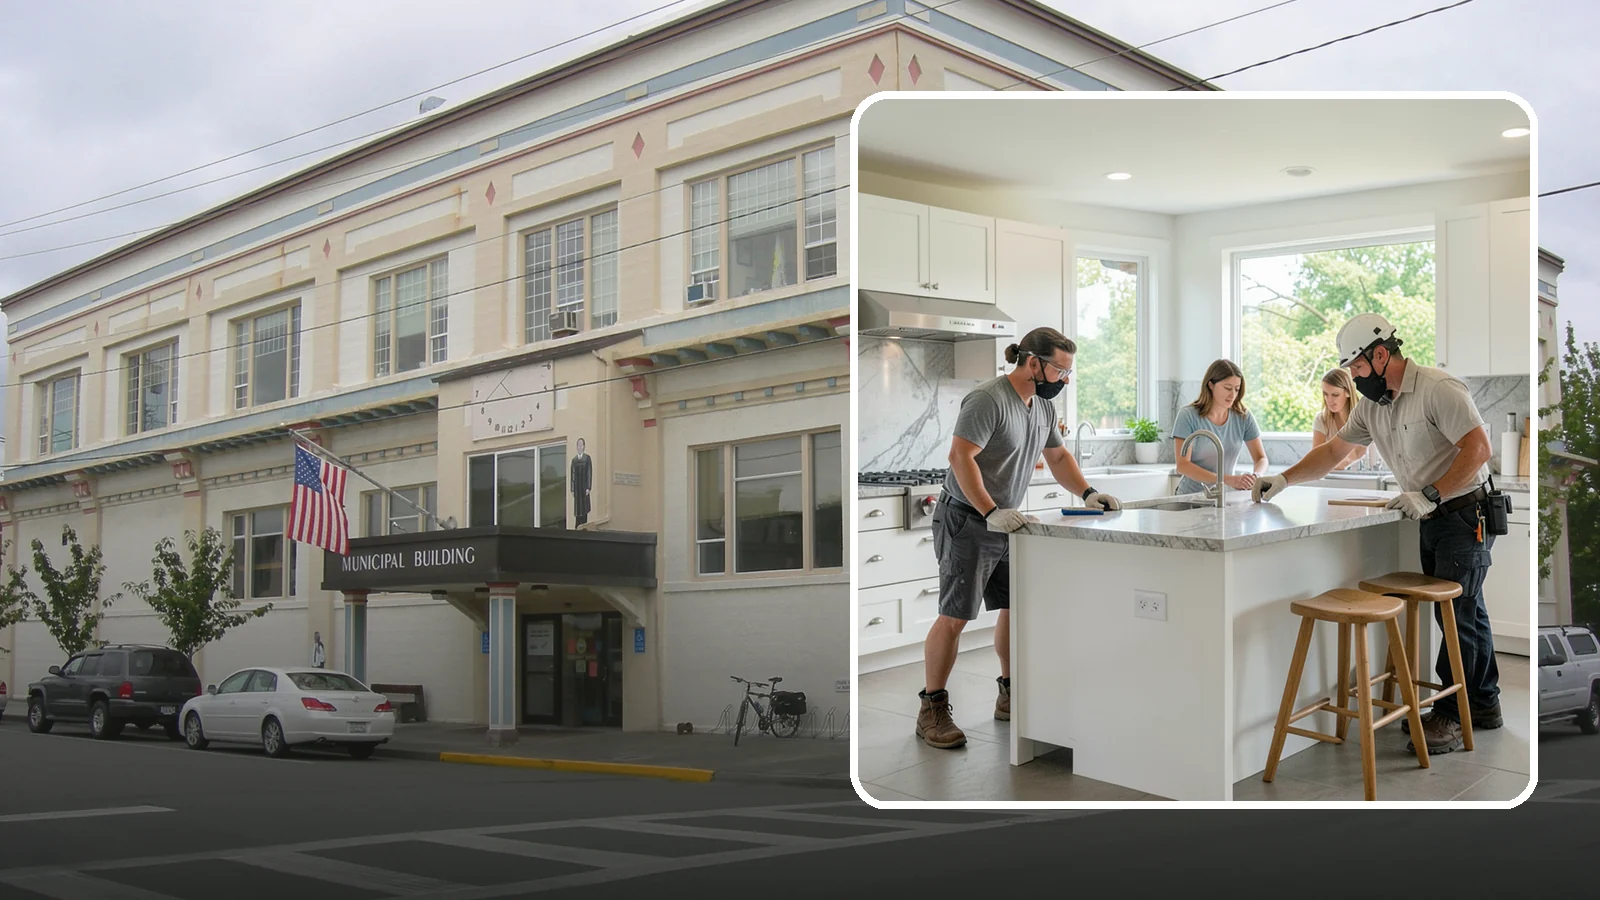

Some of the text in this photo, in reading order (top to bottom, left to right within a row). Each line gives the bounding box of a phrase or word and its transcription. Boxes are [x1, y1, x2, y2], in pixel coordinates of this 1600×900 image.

[475, 390, 479, 398] 7
[536, 402, 540, 410] 4
[481, 407, 485, 415] 8
[488, 417, 492, 426] 9
[529, 414, 533, 422] 3
[495, 424, 500, 432] 10
[521, 420, 525, 428] 2
[501, 425, 506, 433] 11
[507, 425, 513, 433] 12
[342, 546, 475, 572] MUNICIPAL BUILDING
